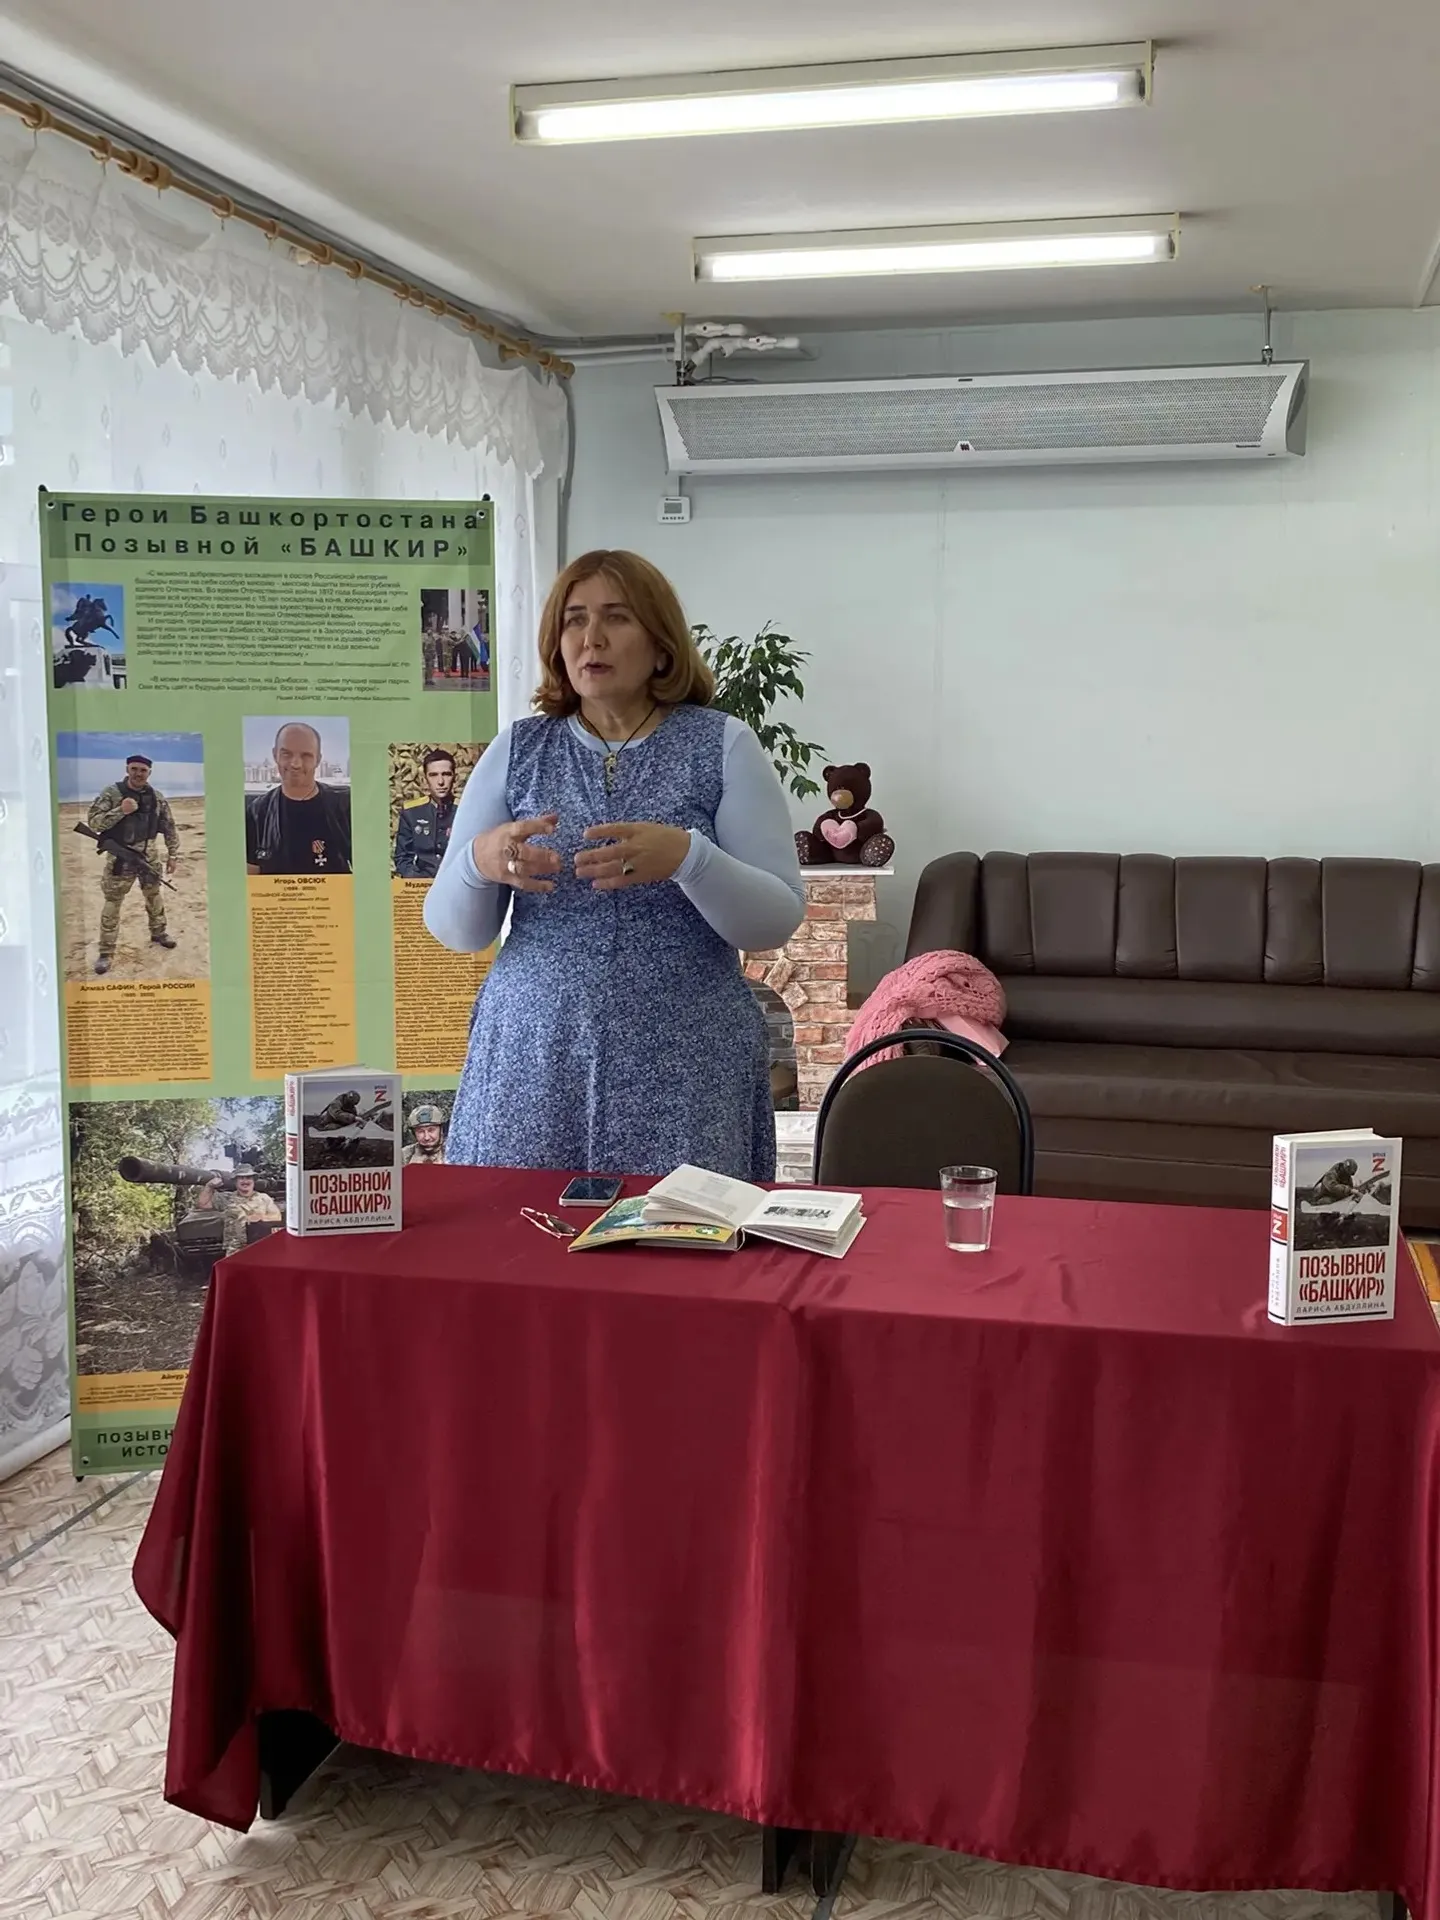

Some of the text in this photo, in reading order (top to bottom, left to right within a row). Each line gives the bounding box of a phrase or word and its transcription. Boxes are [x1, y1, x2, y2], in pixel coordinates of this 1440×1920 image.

[62, 503, 477, 530] Герои Башкортостана
[74, 533, 467, 558] Позывной «БАШКИР»
[374, 1090, 387, 1103] Z
[1372, 1158, 1385, 1172] Z
[310, 1169, 391, 1194] ПОЗЫВНОЙ
[310, 1194, 392, 1215] «БАШКИР»
[344, 1215, 392, 1223] АБДУЛЛИНА
[1300, 1249, 1385, 1278] ПОЗЫВНОЙ
[1299, 1277, 1385, 1302] «БАШКИР»
[1297, 1302, 1385, 1313] ЛАРИСА АБДУЛЛИНА
[98, 1430, 173, 1444] ПОЗЫВН
[122, 1445, 168, 1458] ИСТО
